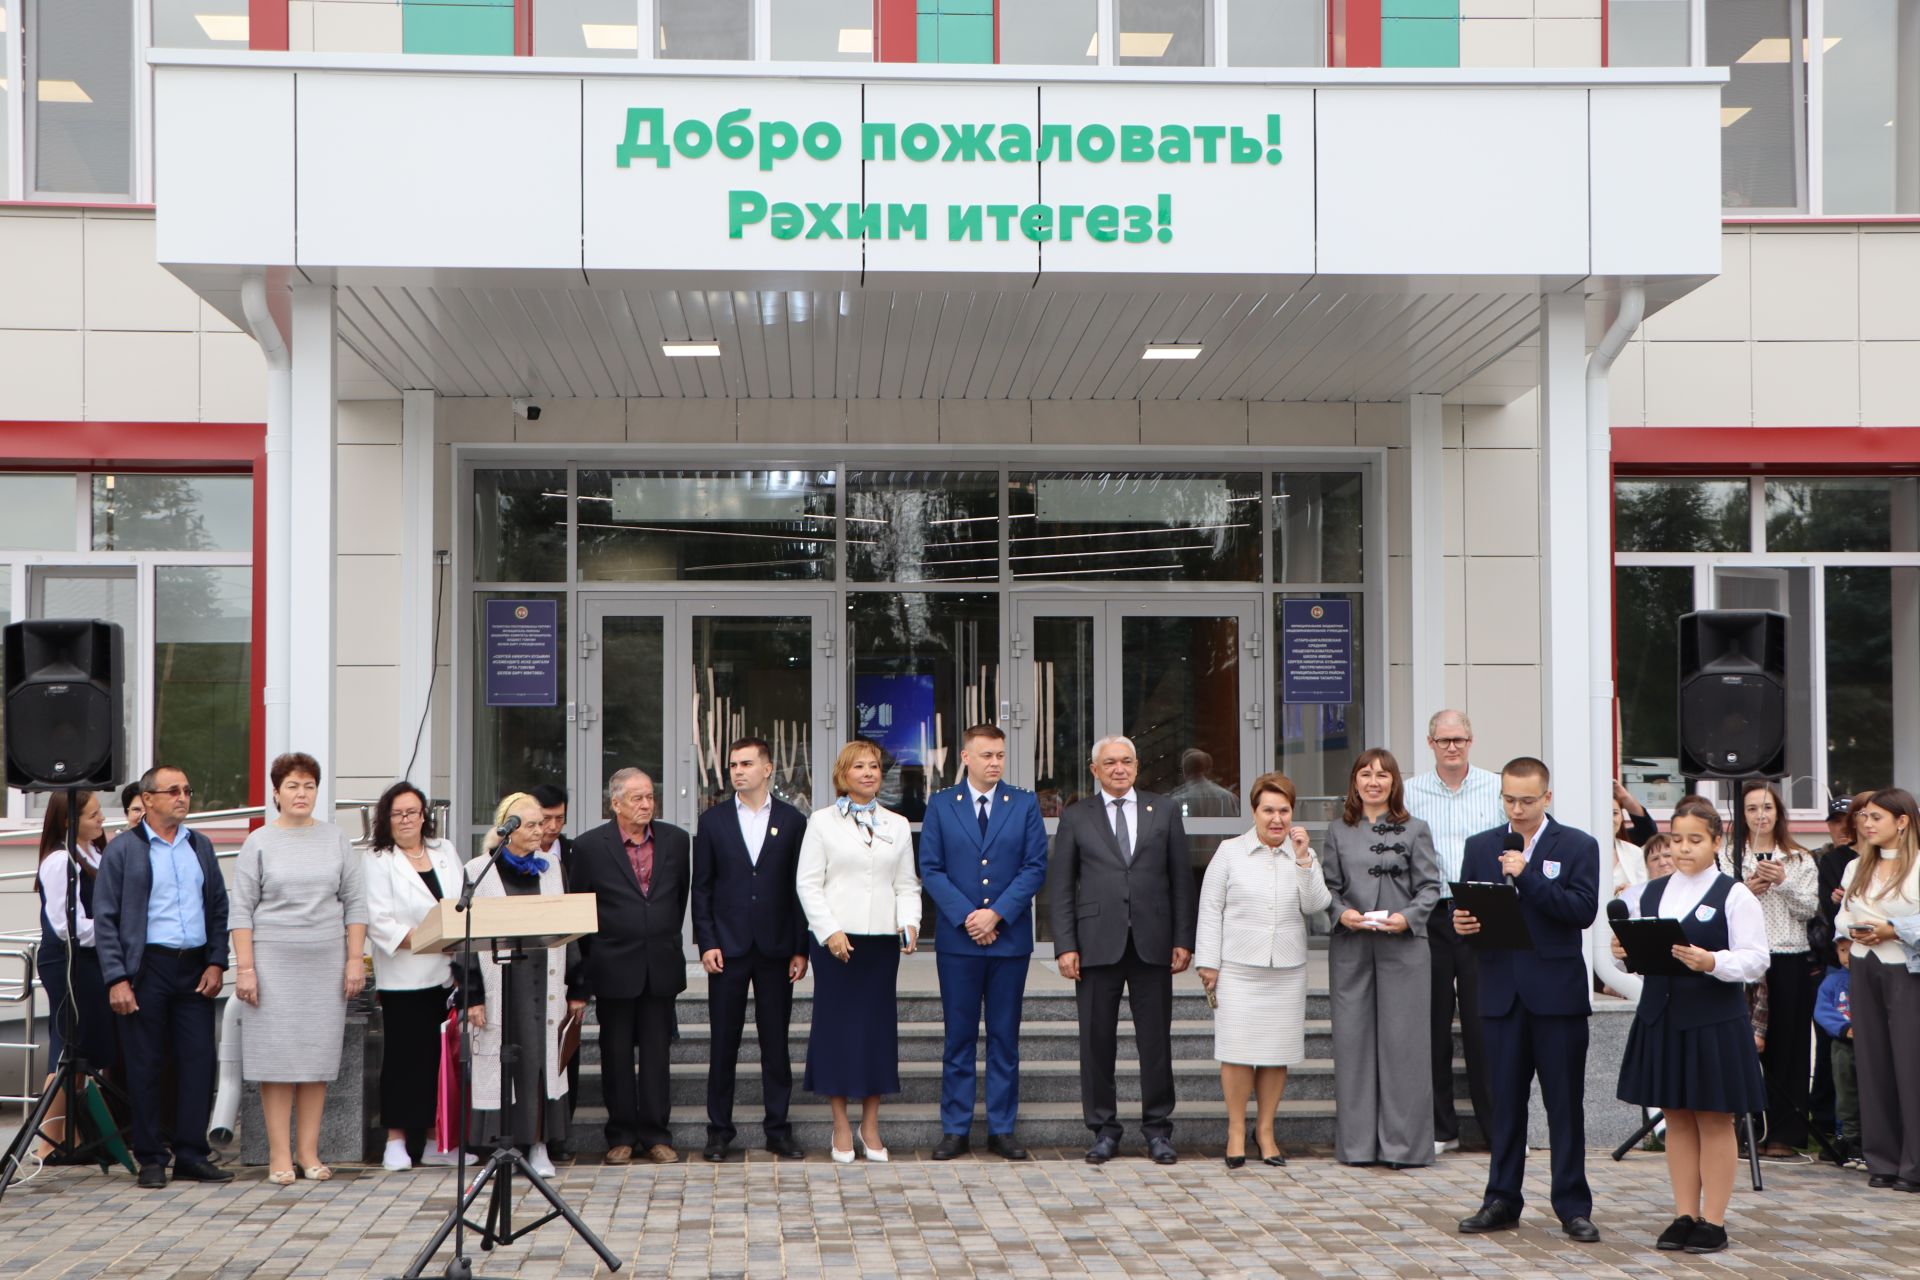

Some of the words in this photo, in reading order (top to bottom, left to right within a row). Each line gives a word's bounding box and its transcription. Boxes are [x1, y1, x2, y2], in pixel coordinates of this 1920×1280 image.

[616, 107, 842, 171] Добро
[861, 113, 1283, 165] пожаловать!
[729, 190, 928, 240] Рәхим
[948, 193, 1173, 243] итегез!
